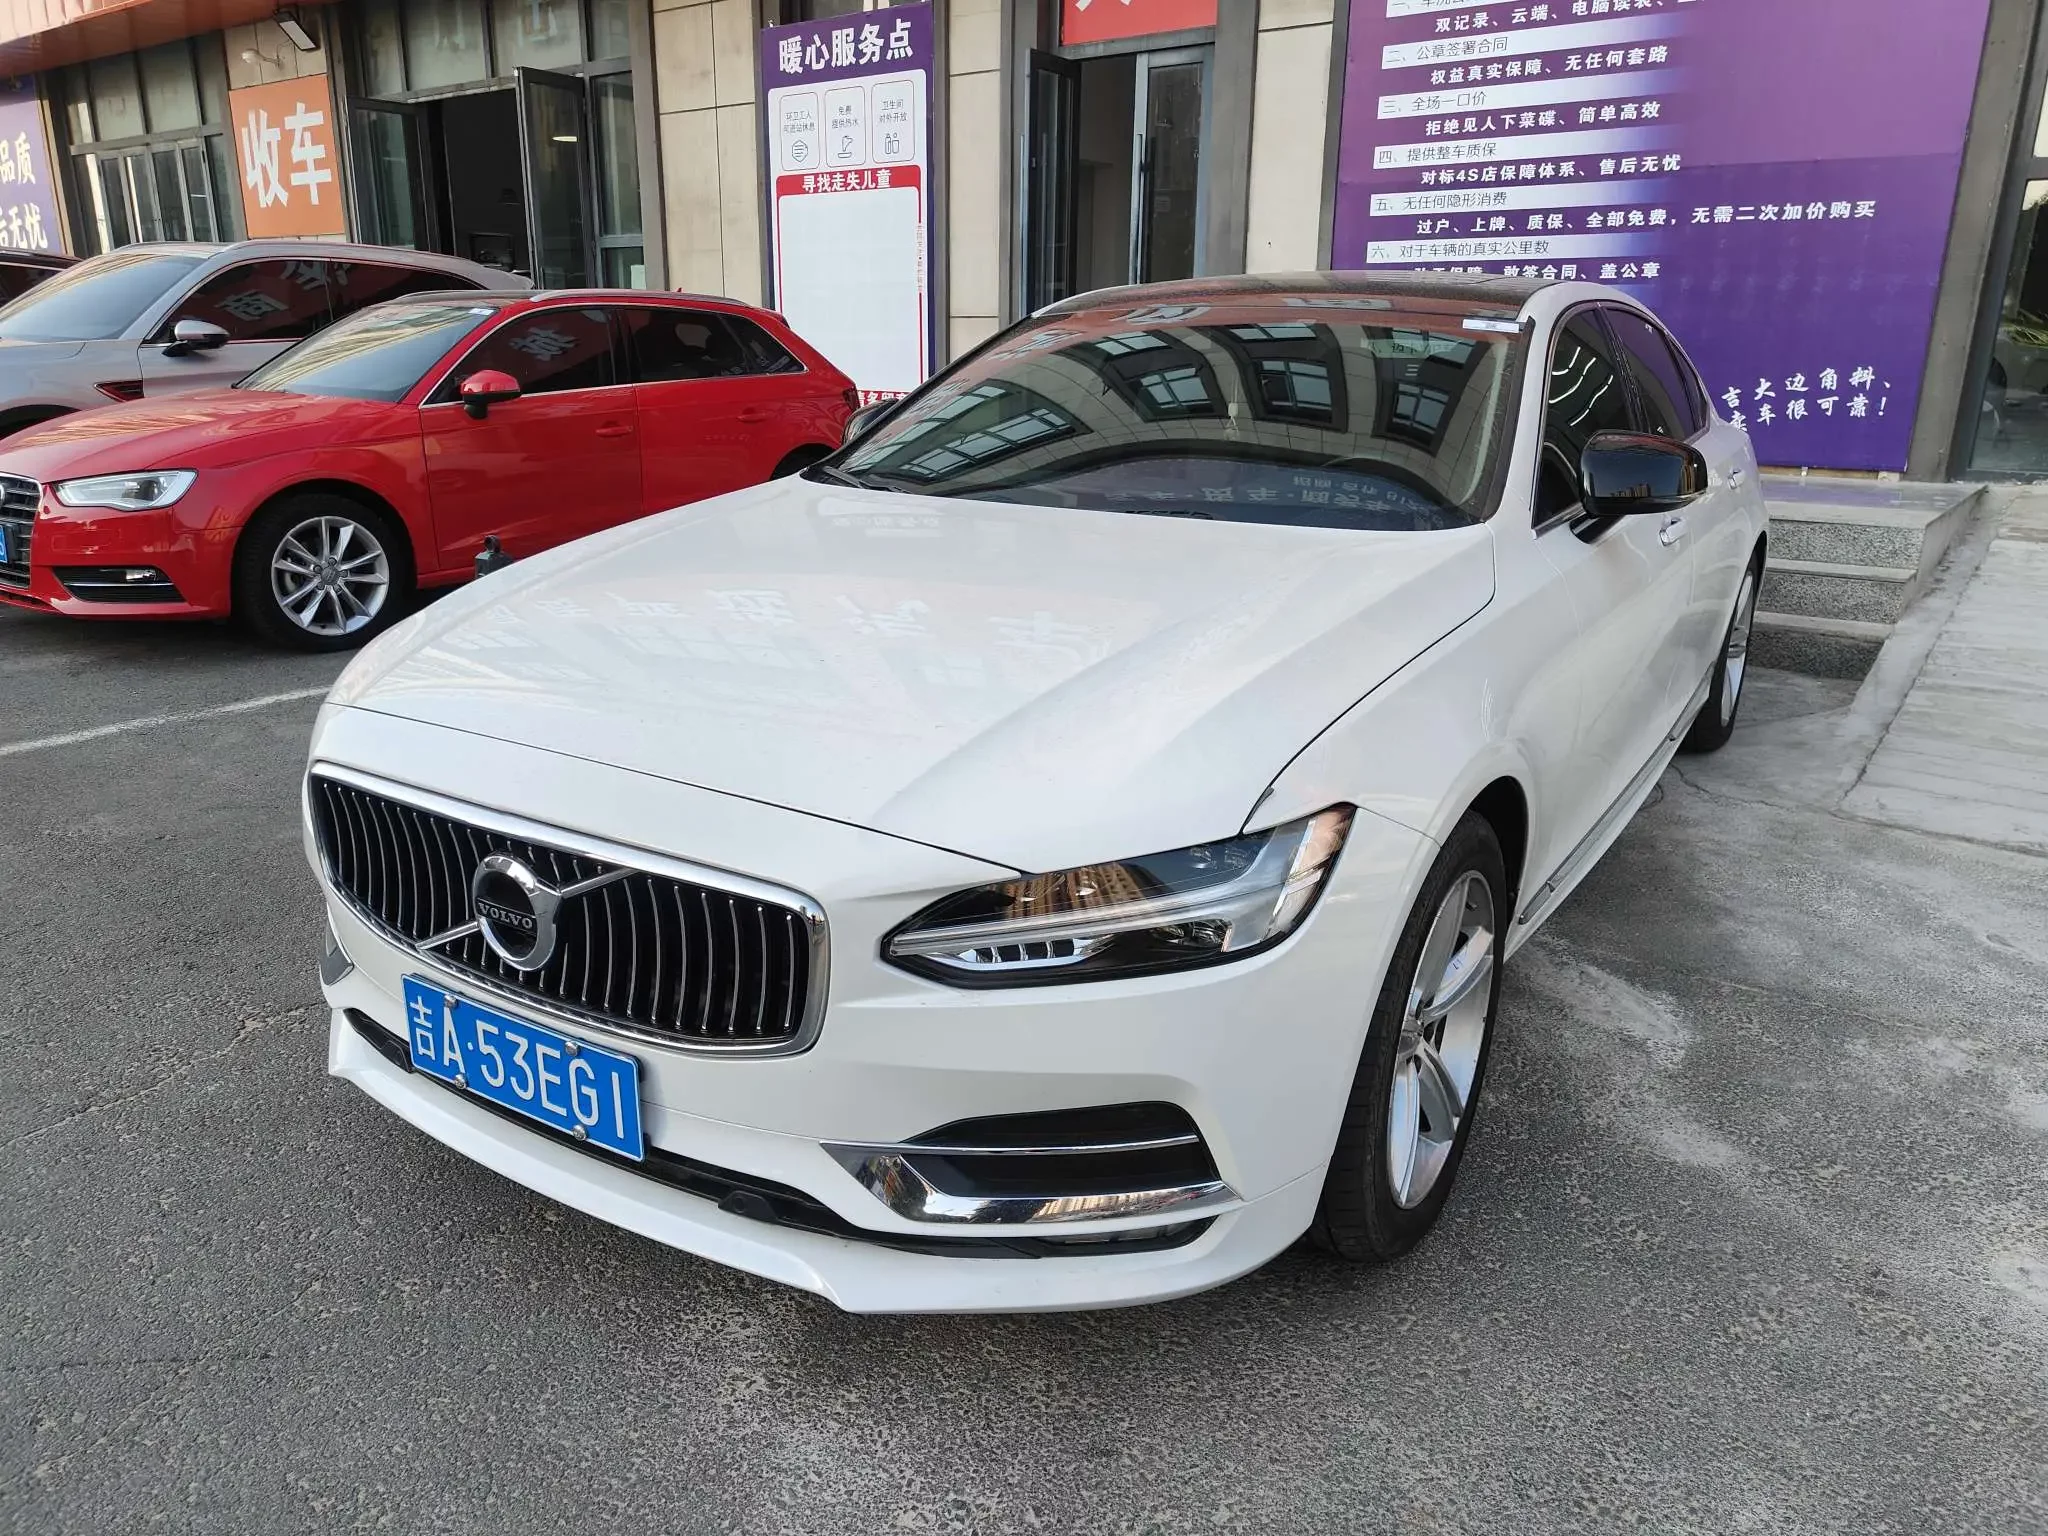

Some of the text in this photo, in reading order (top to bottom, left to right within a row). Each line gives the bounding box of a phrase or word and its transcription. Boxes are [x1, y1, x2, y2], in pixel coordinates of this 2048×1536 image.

[779, 18, 914, 74] 暖心服务点
[1385, 36, 1508, 63] 二、公章签署合同
[1430, 44, 1668, 85] 权益真实保障、无任何套路
[1383, 91, 1487, 114] 三、全场一口价
[1425, 100, 1661, 136] 拒绝见人下菜碟、简单高效
[241, 102, 332, 208] 收车
[1378, 142, 1497, 165] 四、提供整车质保
[802, 169, 892, 193] 寻找走失儿童
[1421, 153, 1682, 186] 对标4S店保障体系、售后无忧
[1375, 191, 1508, 212] 五、无任何隐形消费
[1371, 239, 1550, 260] 六、对于车辆的真实公里数
[478, 902, 534, 929] VOLVO
[409, 995, 625, 1139] 吉A·53EG1
